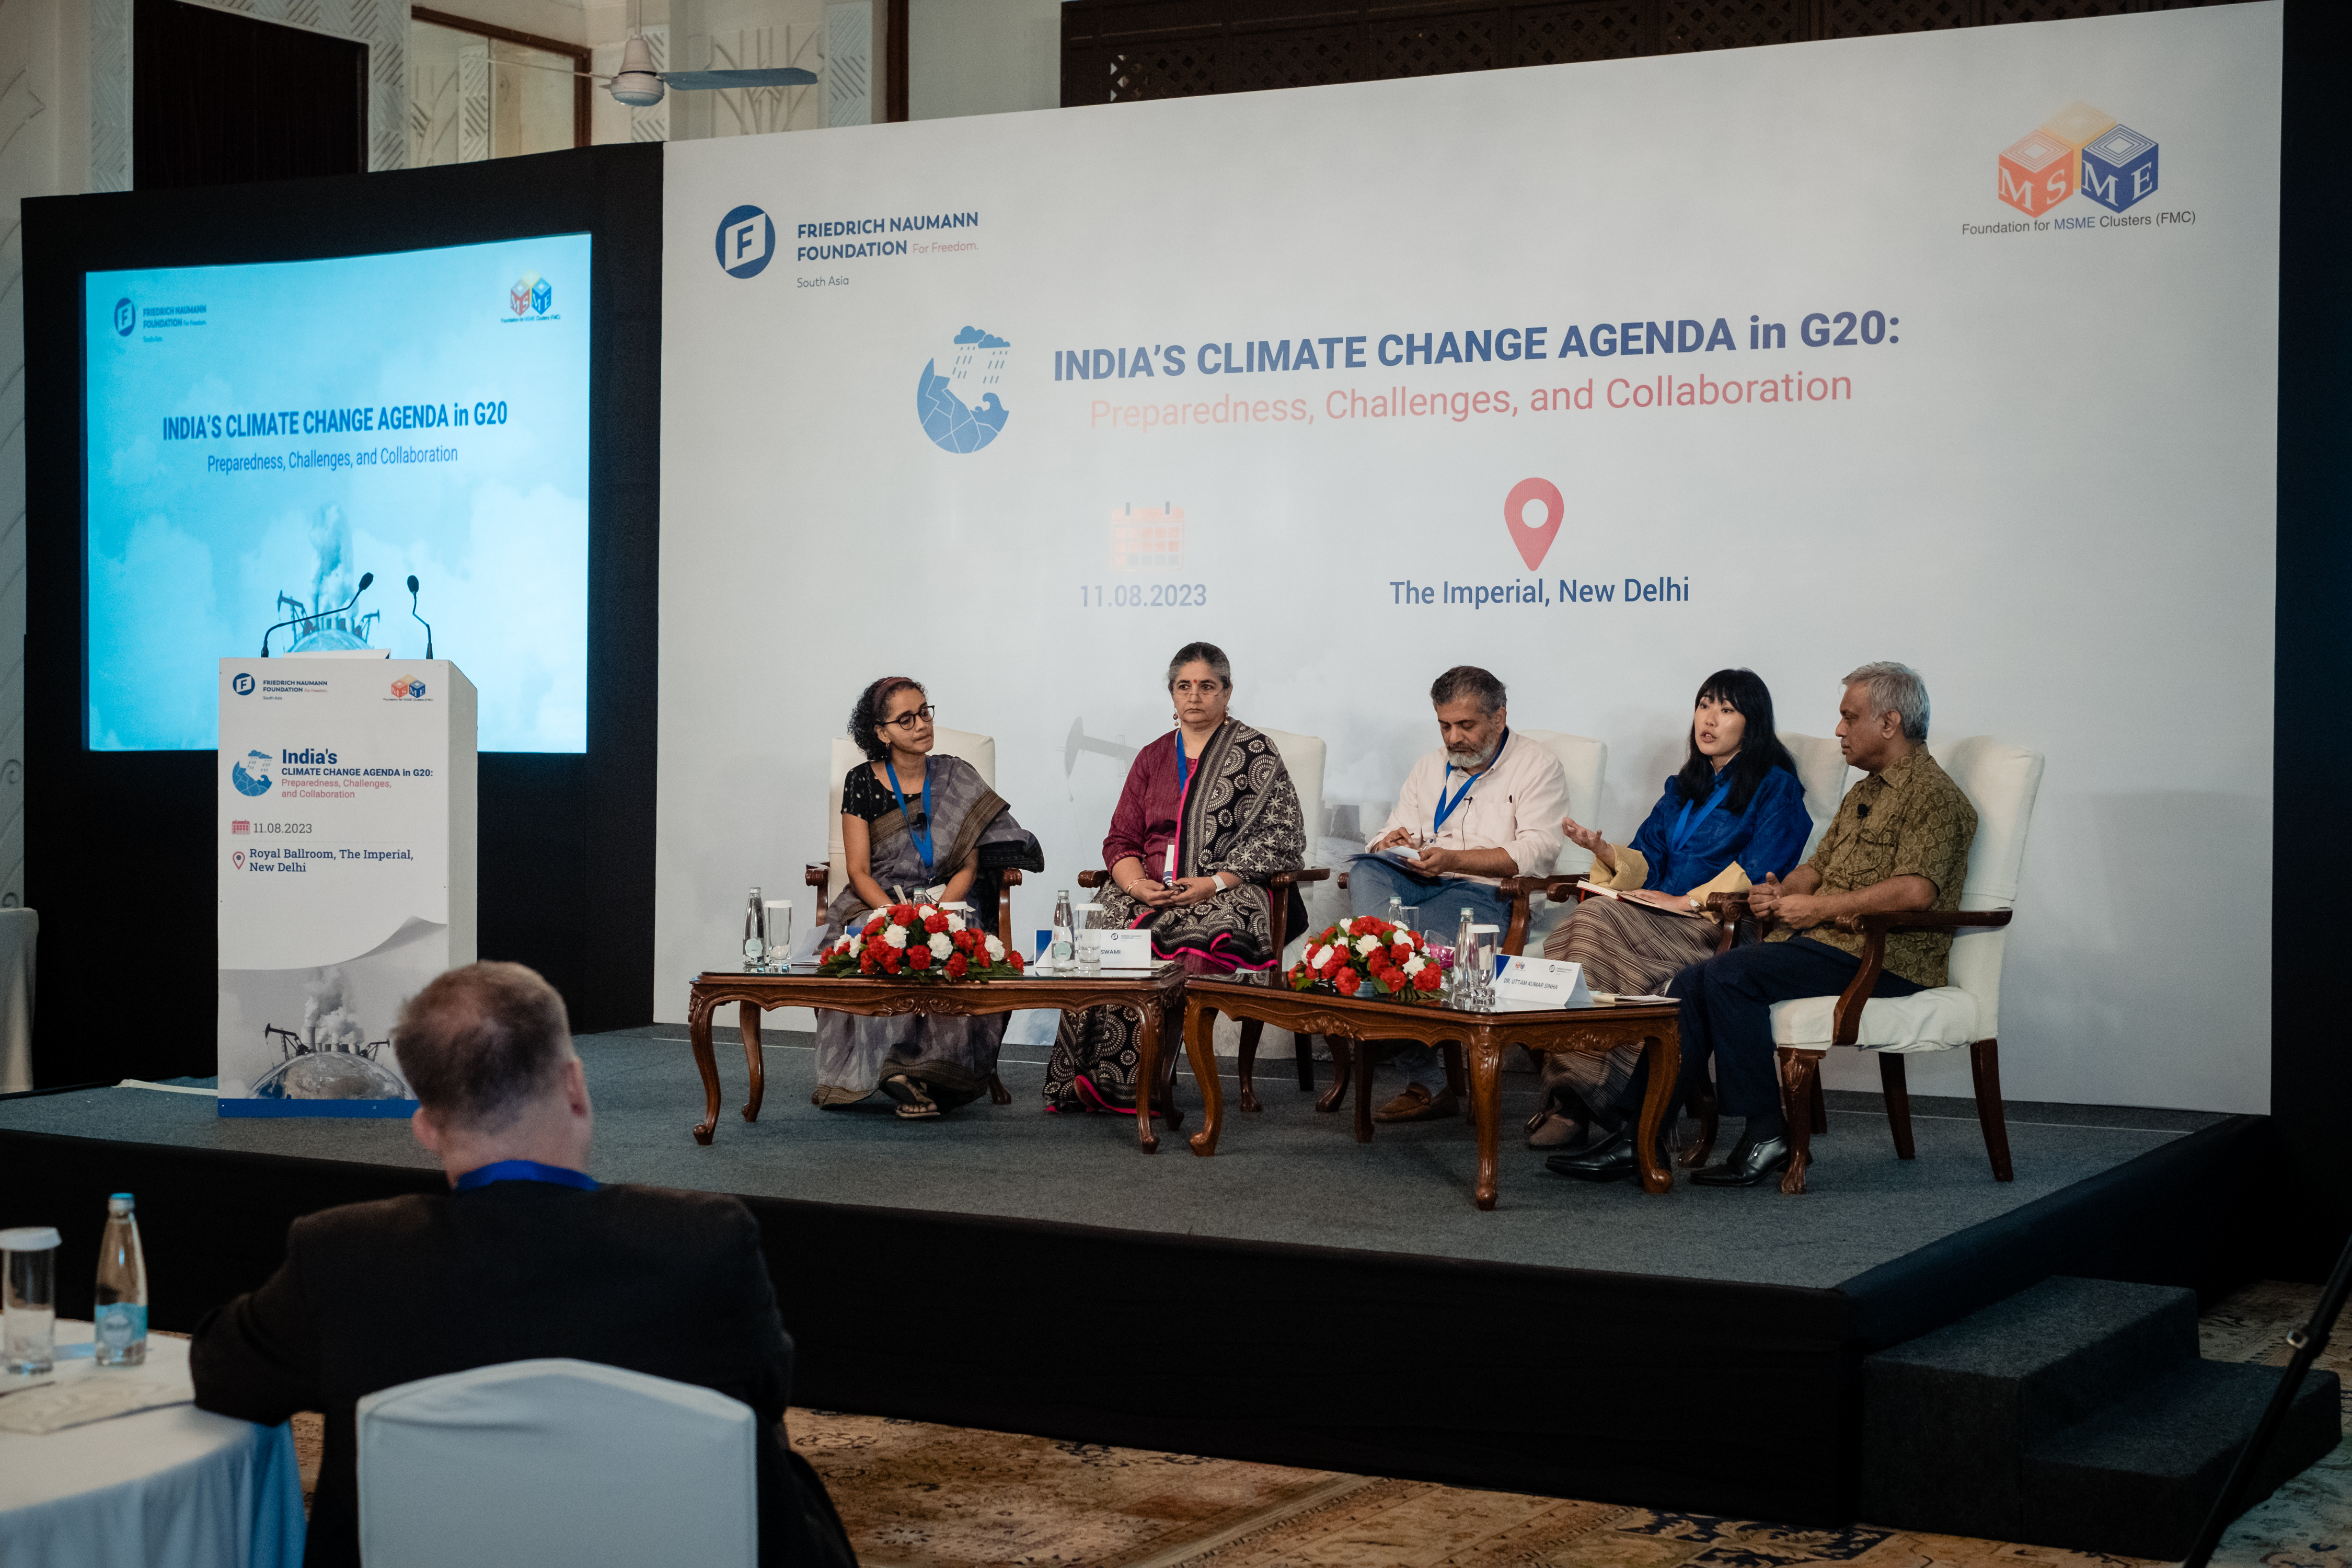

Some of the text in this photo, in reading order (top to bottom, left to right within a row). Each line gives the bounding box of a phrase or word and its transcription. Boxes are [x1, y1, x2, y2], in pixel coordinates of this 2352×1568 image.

[798, 212, 978, 238] FRIEDRICH NAUMANN
[1962, 211, 2196, 235] Foundation for MSME Clusters (FMC)
[798, 240, 978, 261] FOUNDATION For Freedom.
[797, 275, 849, 288] South Asia
[143, 305, 207, 317] FRIEDRICH NAUMANN
[143, 318, 182, 329] FOUNDATION
[1055, 310, 1900, 381] INDIA’S CLIMATE CHANGE AGENDA in G20:
[1090, 371, 1852, 433] Preparedness, Challenges, and Collaboration
[225, 411, 299, 438] CLIMATE
[303, 407, 373, 434] CHANGE
[377, 404, 449, 431] AGENDA
[454, 402, 469, 427] in
[474, 400, 508, 425] G20
[207, 445, 458, 475] Preparedness, Challenges, and Collaboration
[1080, 583, 1207, 608] 11.08.2023
[1390, 575, 1690, 609] The Imperial, New Delhi
[282, 748, 338, 765] India's
[403, 768, 410, 777] in
[282, 778, 391, 789] Preparedness, Challenges,
[299, 790, 355, 798] Collaboration
[253, 823, 313, 834] 11.08.2023
[249, 848, 413, 861] Royal Ballroom, The Imperial,
[249, 862, 306, 872] New Delhi
